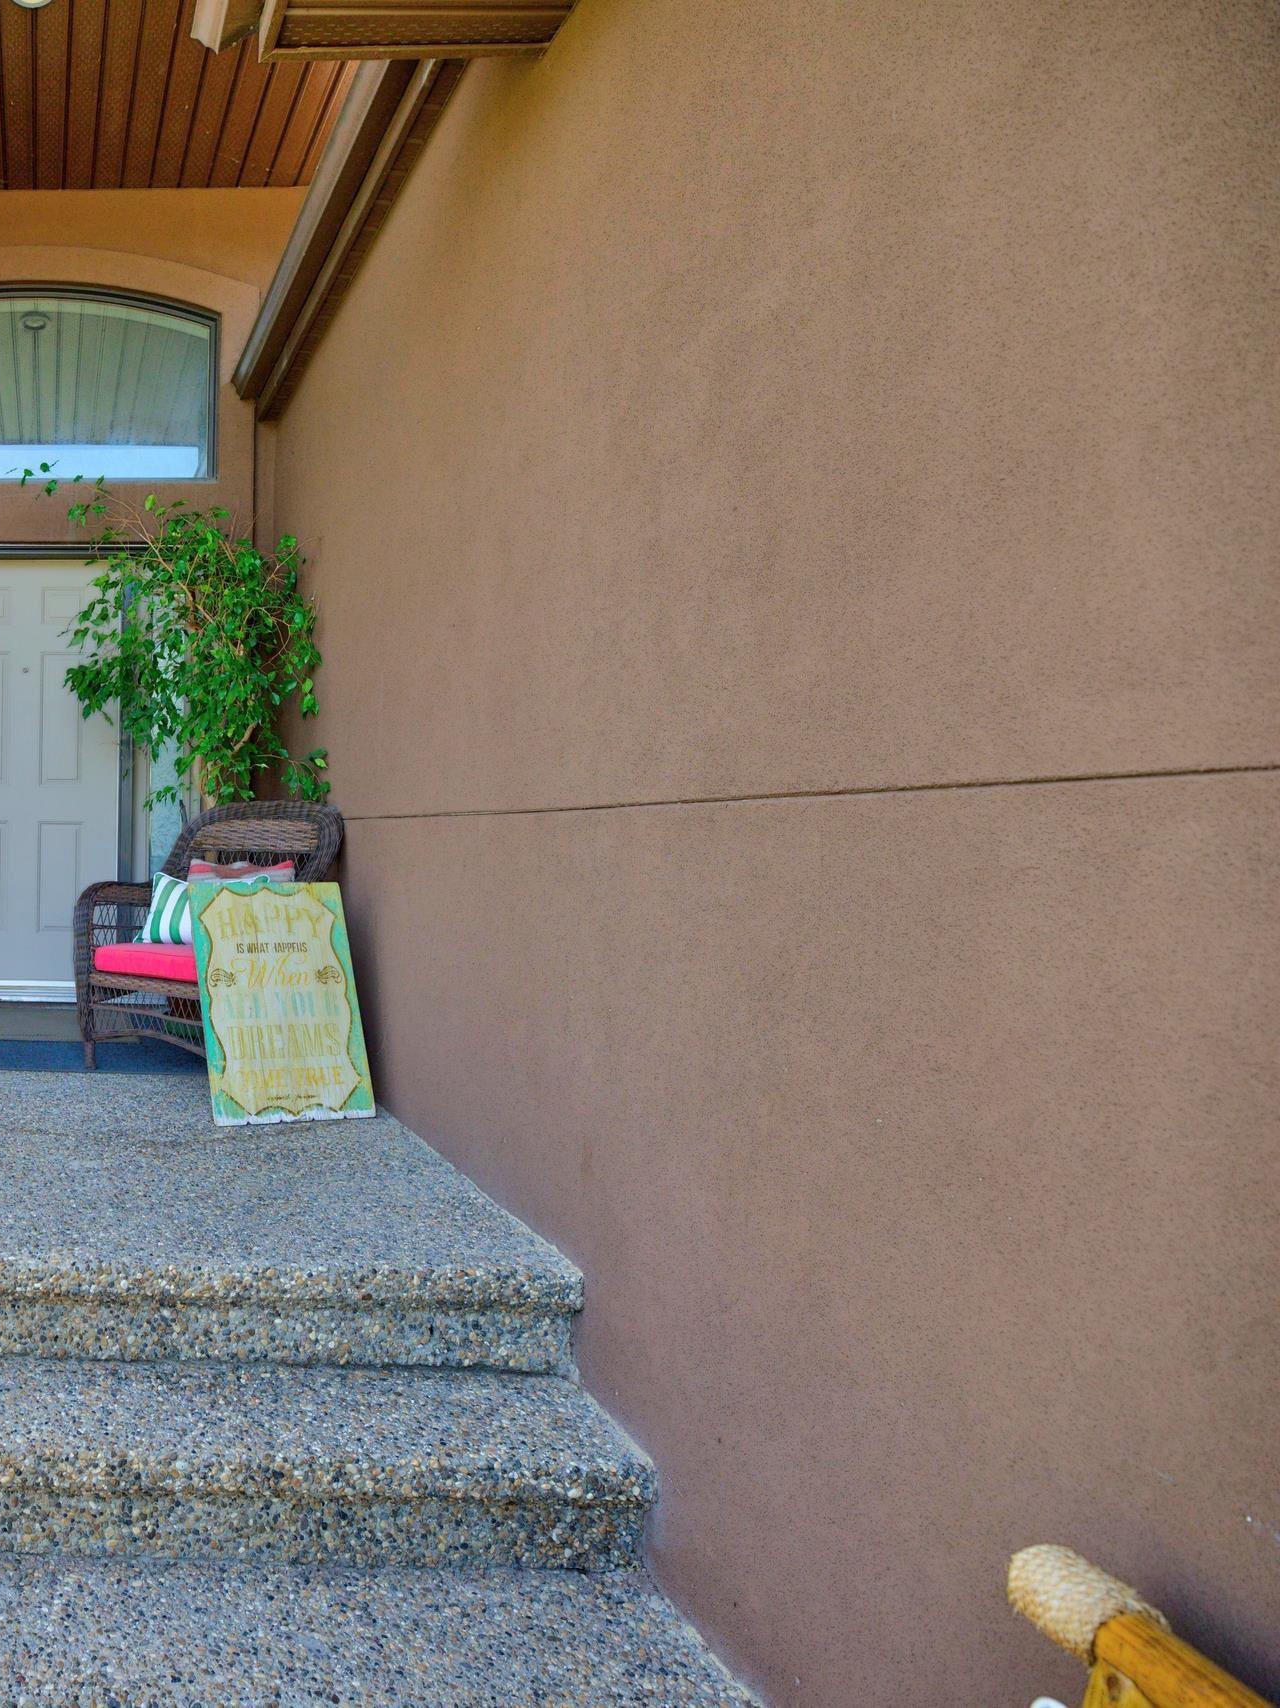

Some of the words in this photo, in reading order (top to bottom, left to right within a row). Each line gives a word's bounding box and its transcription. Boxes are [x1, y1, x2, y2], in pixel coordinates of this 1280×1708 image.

[217, 903, 325, 940] HAPPY
[236, 943, 245, 954] IS
[247, 942, 270, 954] WHAT
[273, 942, 308, 953] HAPPENS
[231, 954, 310, 989] When
[227, 1023, 342, 1061] DREAMS
[293, 1065, 344, 1088] TRUE
